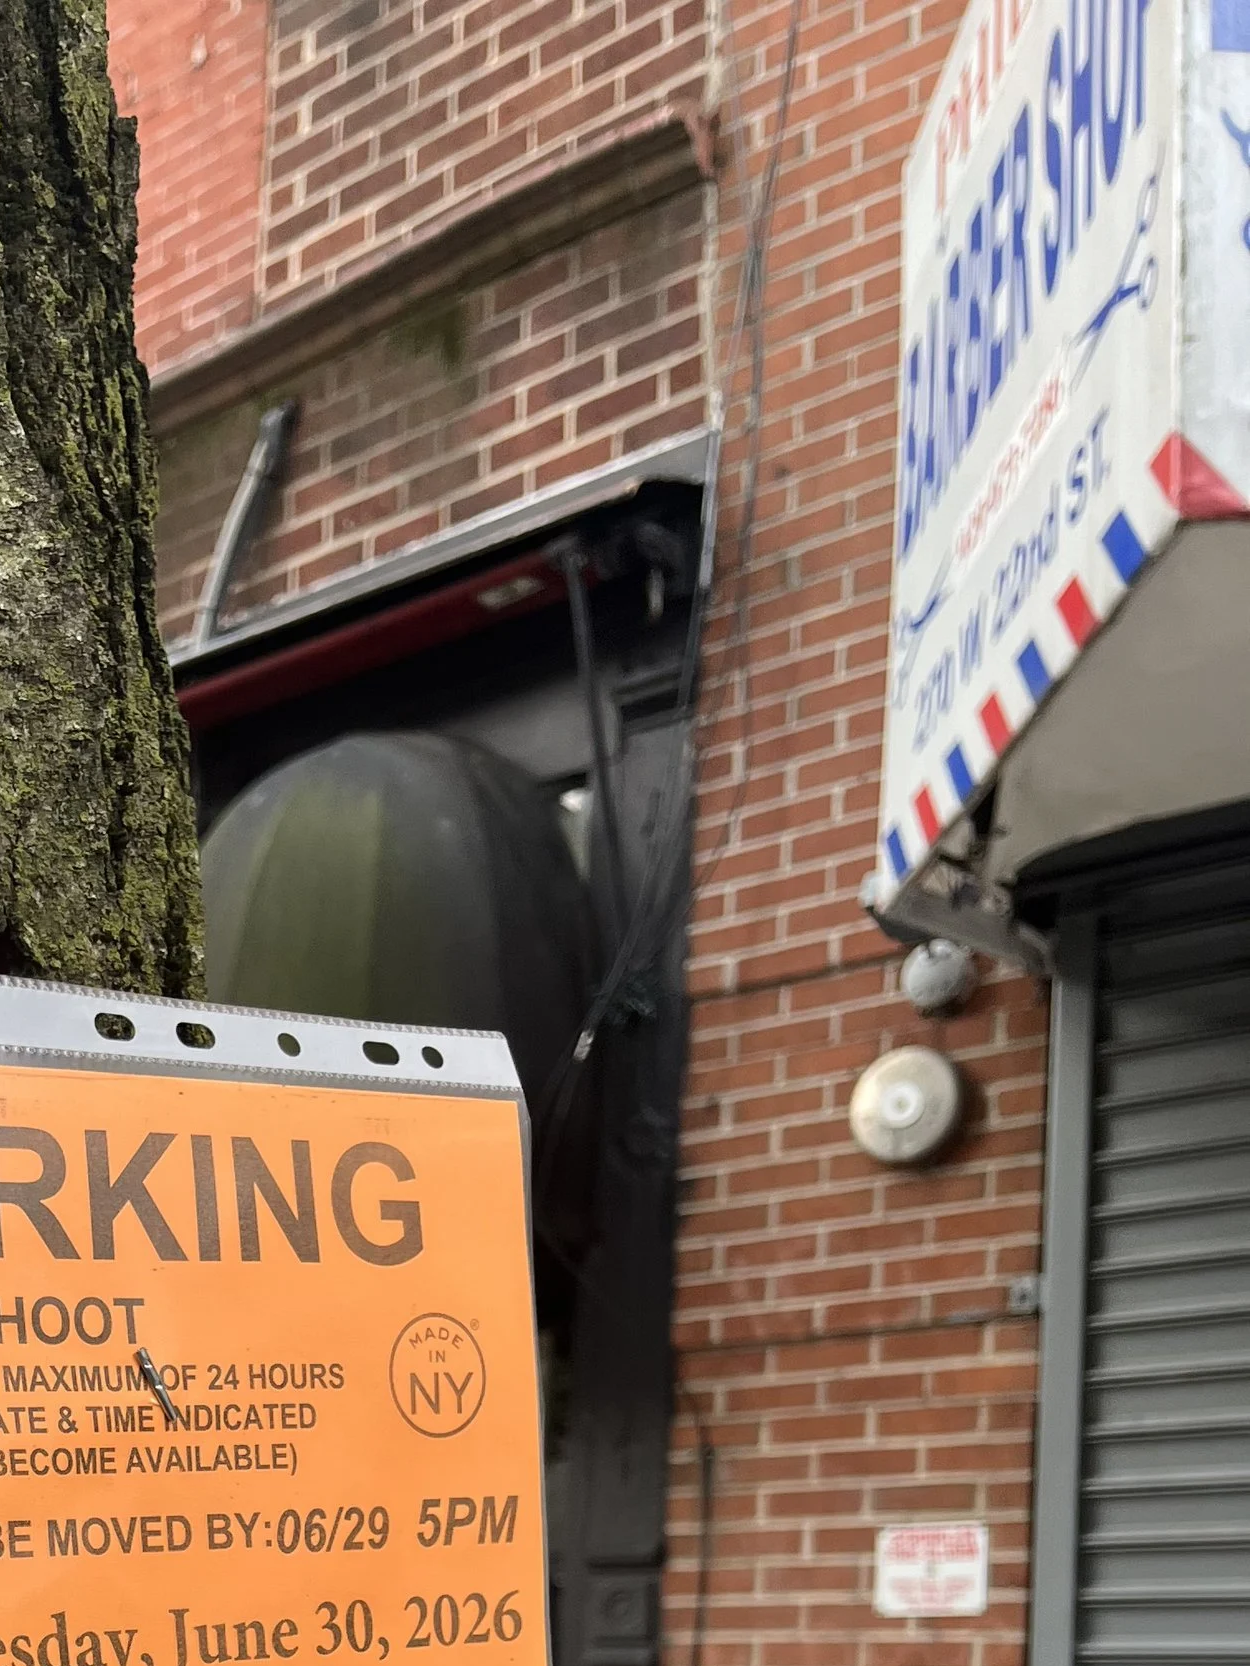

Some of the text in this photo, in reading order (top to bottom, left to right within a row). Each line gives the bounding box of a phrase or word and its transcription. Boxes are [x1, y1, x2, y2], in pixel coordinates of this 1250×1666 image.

[900, 100, 1032, 562] BARBER
[408, 1327, 464, 1350] MADE
[428, 1350, 446, 1363] IN
[2, 1364, 149, 1393] MAXIMUM
[161, 1364, 197, 1392] OF
[206, 1363, 240, 1391] 24
[248, 1362, 345, 1390] HOURS
[409, 1372, 474, 1415] NY
[57, 1405, 79, 1434] &
[85, 1405, 155, 1433] TIME
[125, 1442, 298, 1477] AVAILABLE)
[46, 1514, 193, 1557] MOVED
[416, 1495, 519, 1548] 5PM
[314, 1599, 390, 1661] 30,
[404, 1589, 523, 1649] 2026
